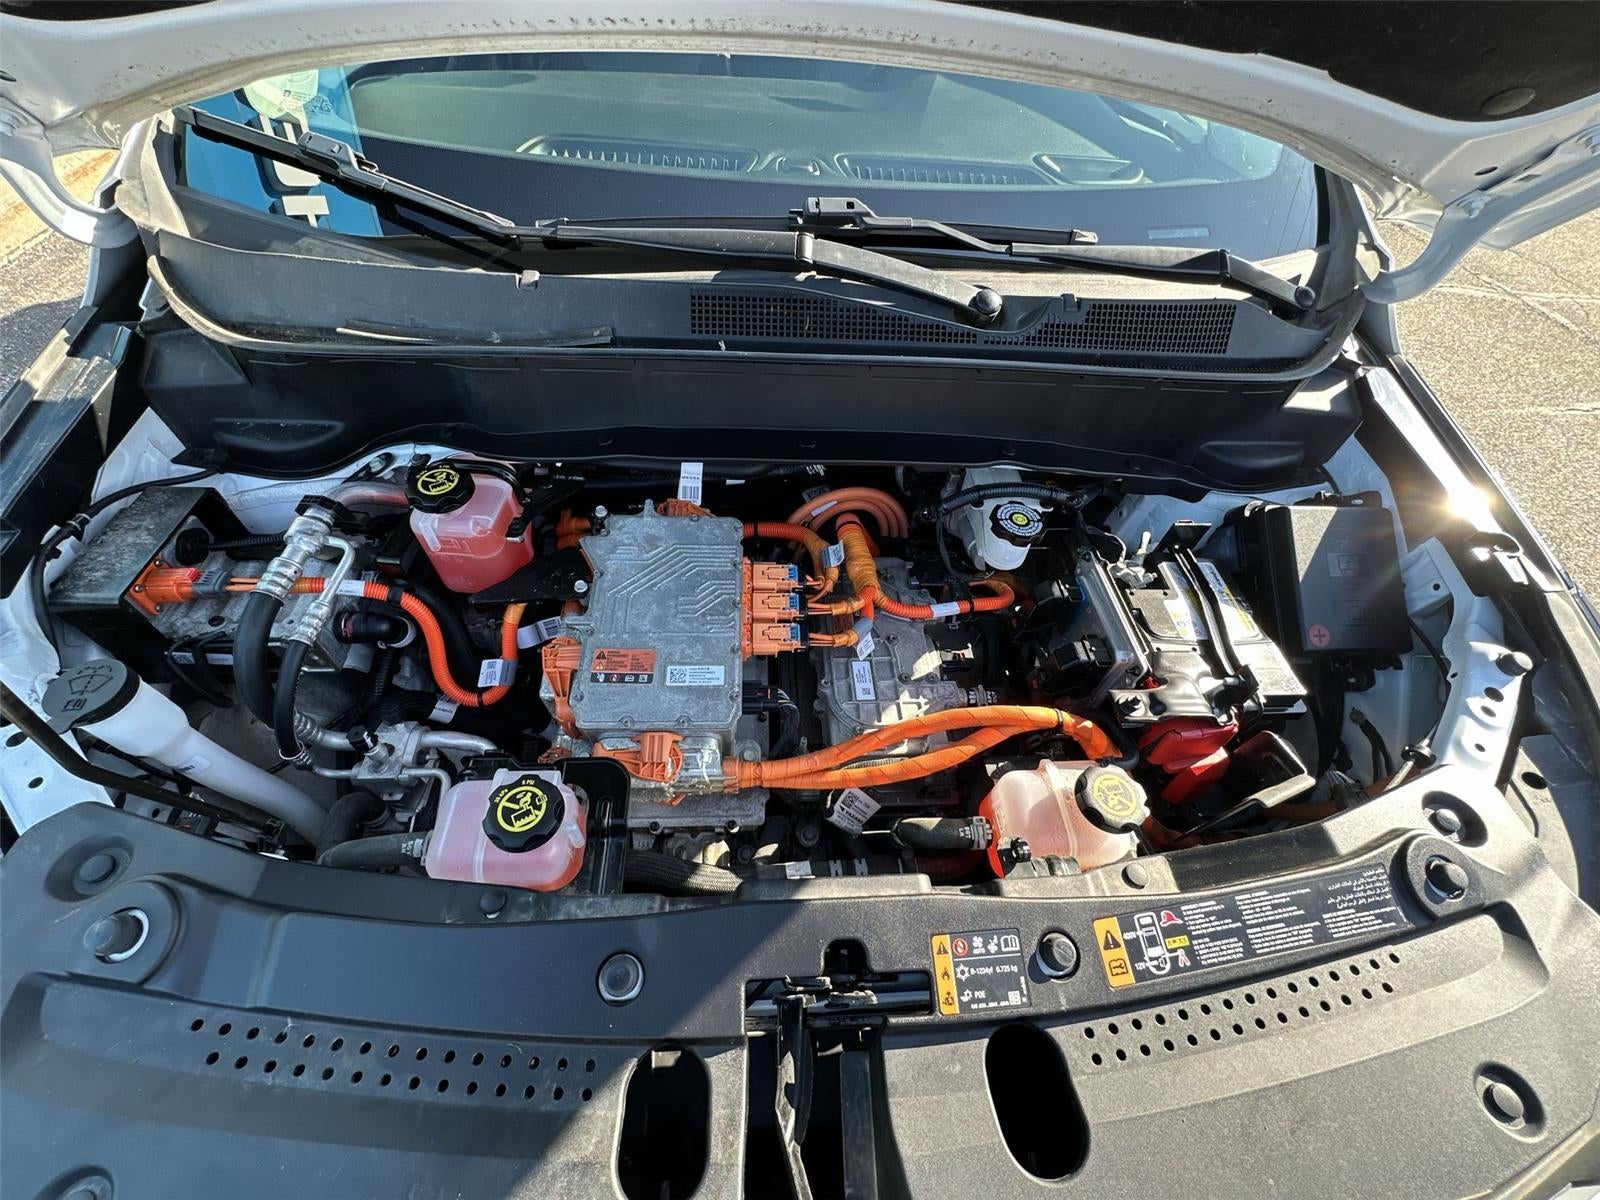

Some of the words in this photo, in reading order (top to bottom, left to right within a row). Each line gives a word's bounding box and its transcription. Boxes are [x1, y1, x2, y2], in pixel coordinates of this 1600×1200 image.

[1123, 931, 1137, 940] 400V
[995, 965, 1010, 973] 0.725
[1010, 965, 1018, 973] kg
[1134, 961, 1146, 971] 12V
[974, 990, 986, 999] POE
